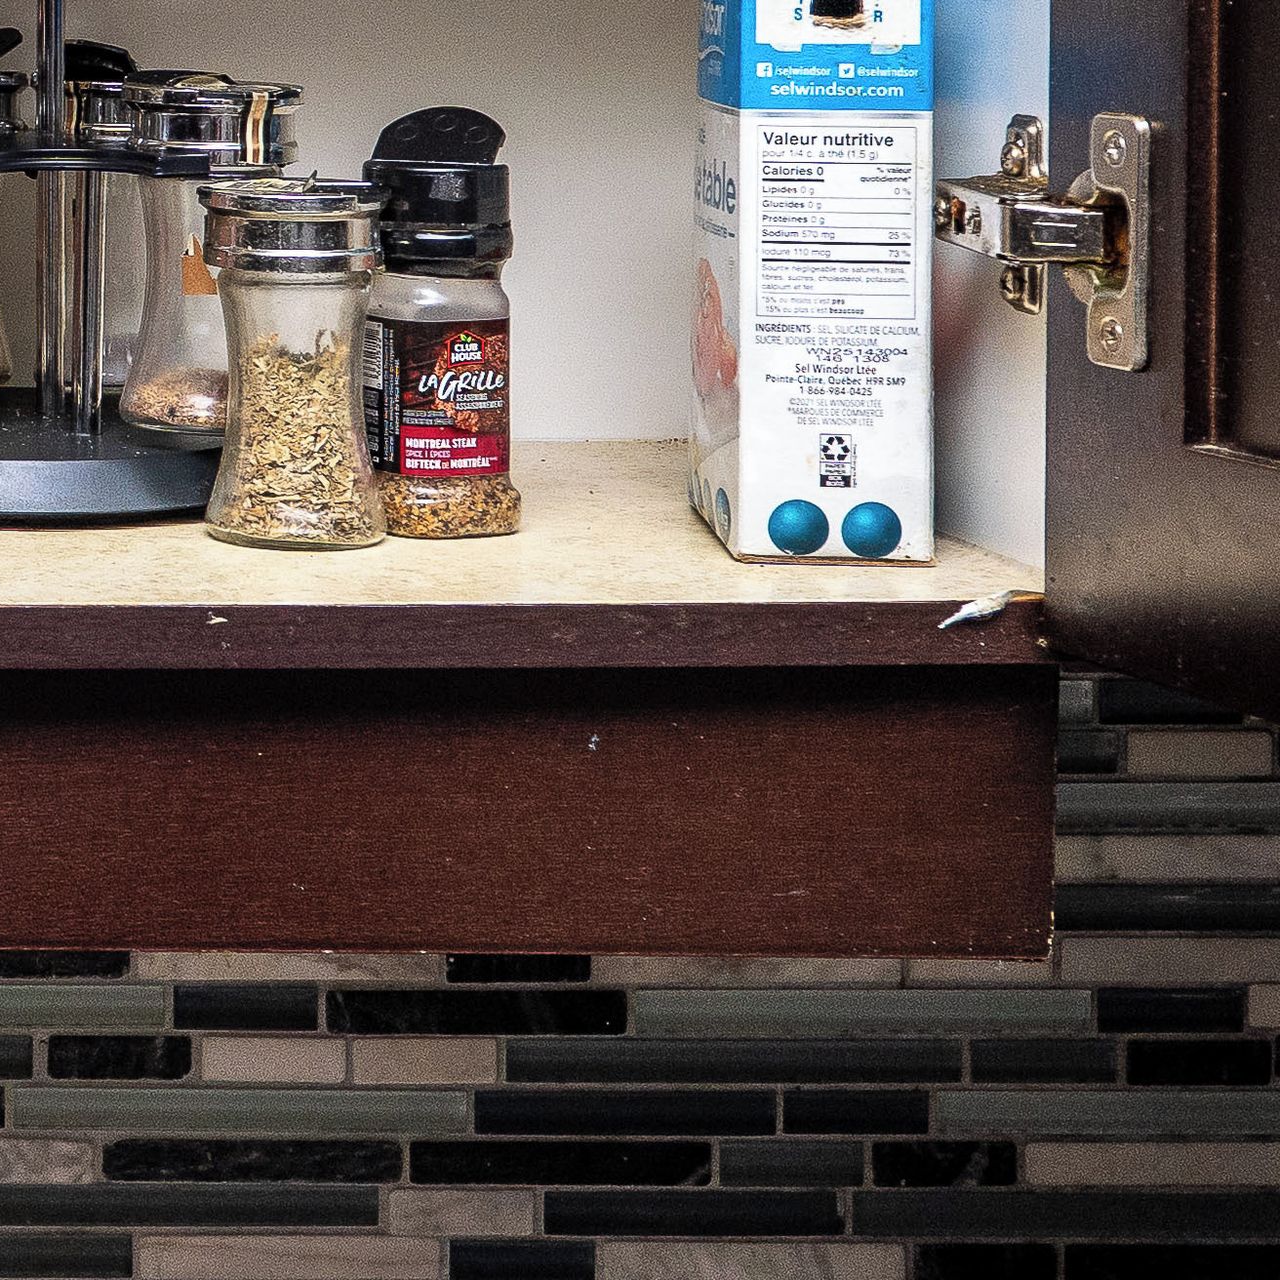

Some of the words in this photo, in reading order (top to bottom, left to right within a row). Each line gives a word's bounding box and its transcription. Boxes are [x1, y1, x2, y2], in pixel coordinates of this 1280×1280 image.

[770, 82, 904, 97] selwindsor.com
[764, 132, 817, 145] Valeur
[824, 133, 894, 147] nutritive
[763, 166, 813, 176] Calories
[817, 167, 824, 175] 0
[762, 200, 805, 208] Glucides
[762, 229, 799, 237] Sodium
[755, 323, 811, 333] INGRÉDIENTS
[454, 343, 478, 352] CLUB
[451, 352, 482, 363] HOUSE
[795, 364, 809, 373] Sel
[812, 364, 853, 374] Windsor
[406, 438, 450, 449] MONTREAL
[452, 438, 477, 448] STEAK
